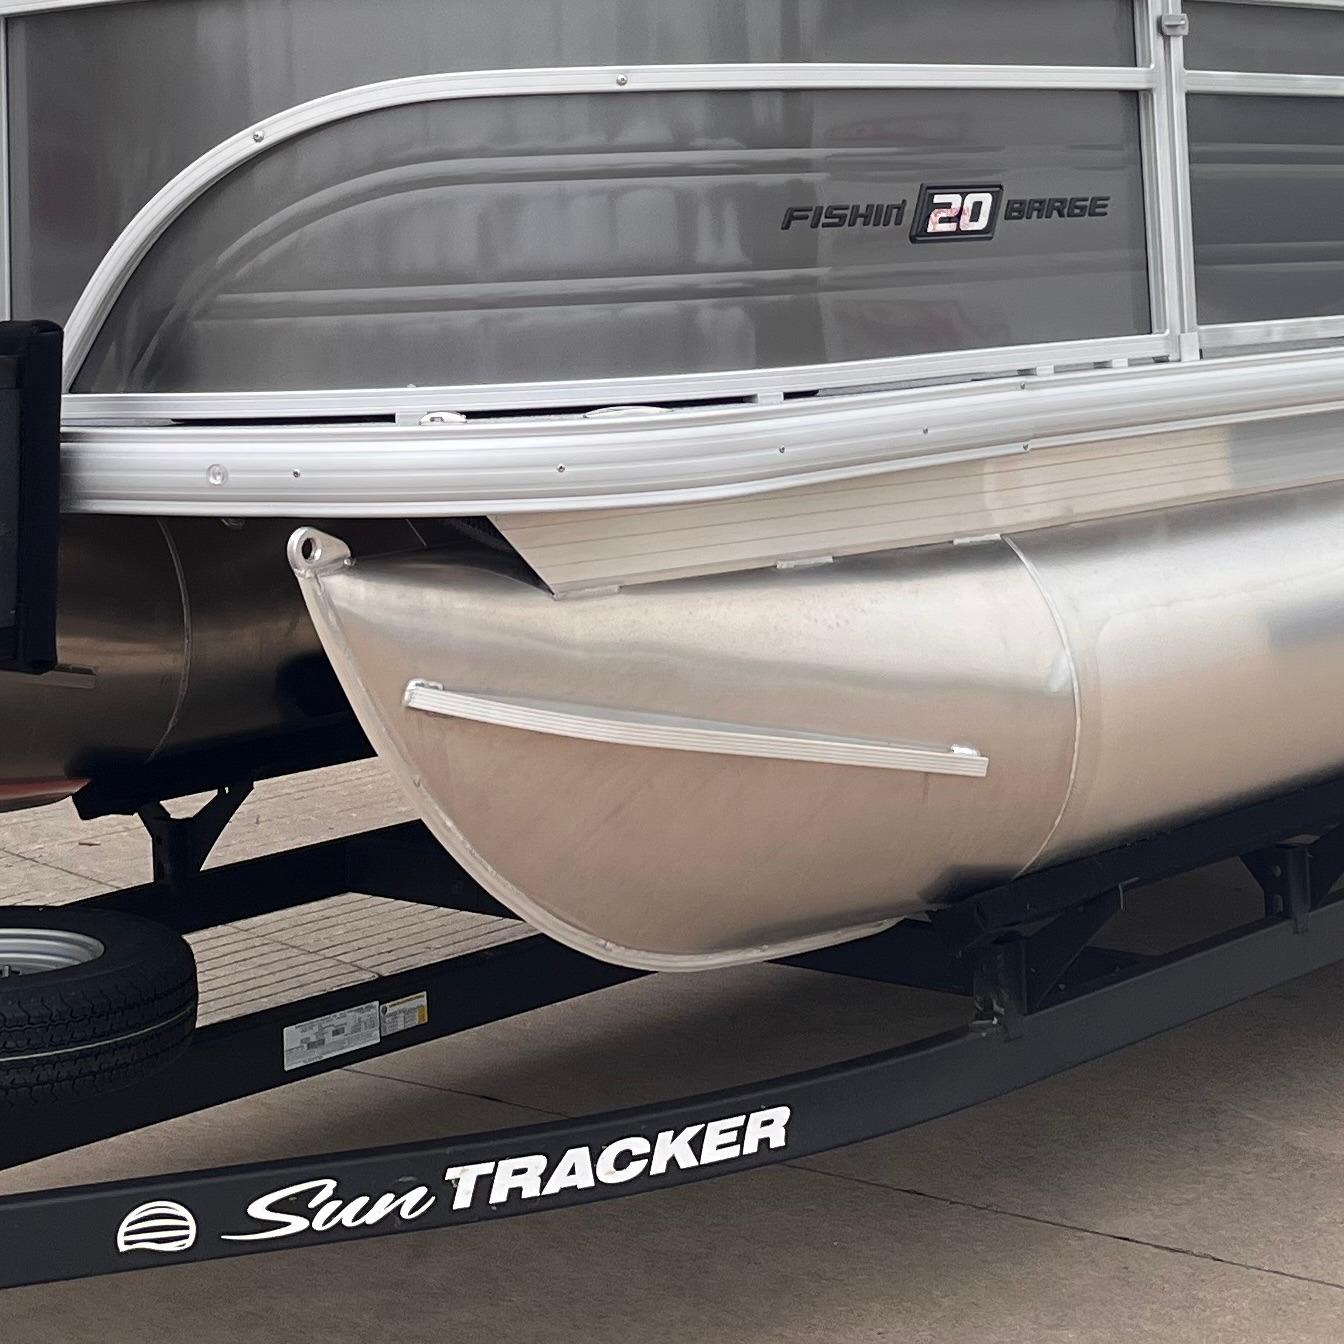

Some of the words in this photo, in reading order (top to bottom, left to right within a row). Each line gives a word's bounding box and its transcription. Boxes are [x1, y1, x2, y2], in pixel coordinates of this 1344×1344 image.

[925, 192, 994, 234] 20
[1004, 195, 1111, 221] BARGE
[220, 1178, 437, 1241] Sun
[443, 1104, 793, 1211] TRACKER
